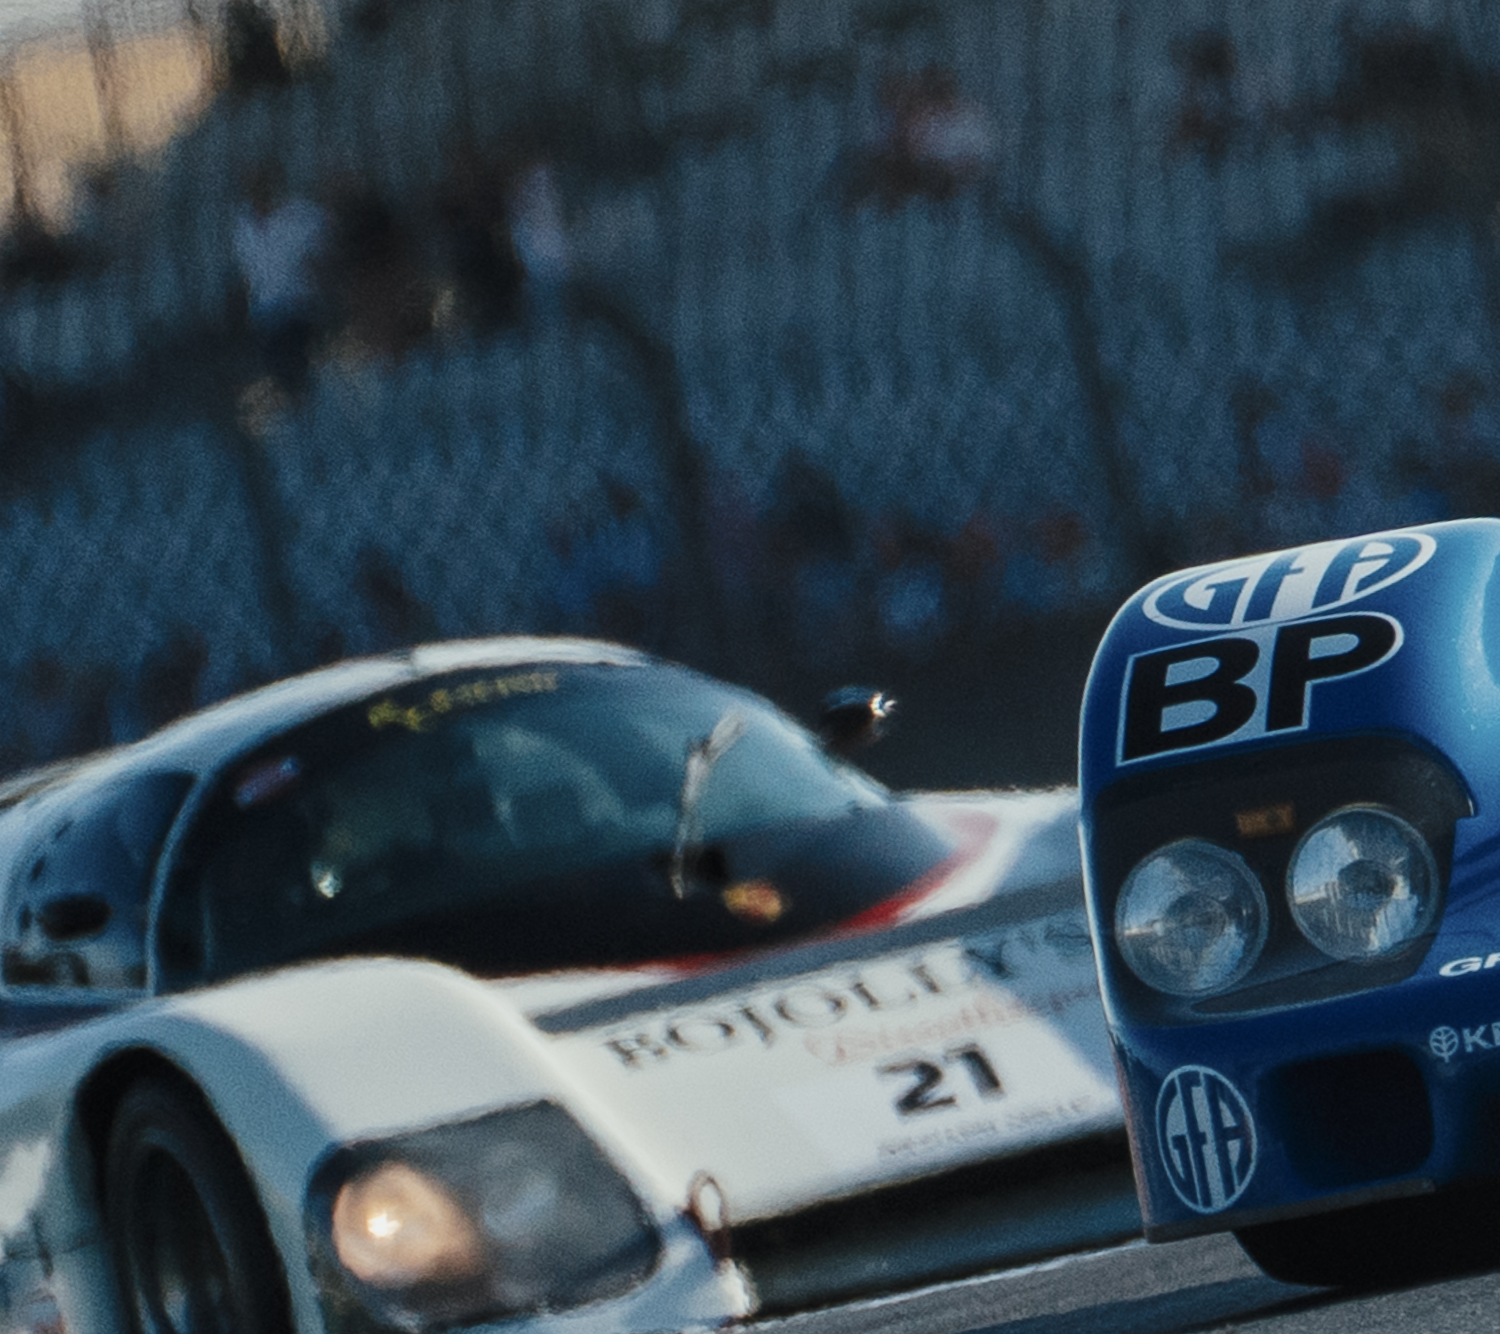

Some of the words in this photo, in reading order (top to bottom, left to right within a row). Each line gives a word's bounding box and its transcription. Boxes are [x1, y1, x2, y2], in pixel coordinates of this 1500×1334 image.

[1142, 533, 1437, 631] GFA
[1118, 613, 1402, 764] BP
[874, 1043, 1005, 1119] 21
[1155, 1065, 1258, 1213] GFA
